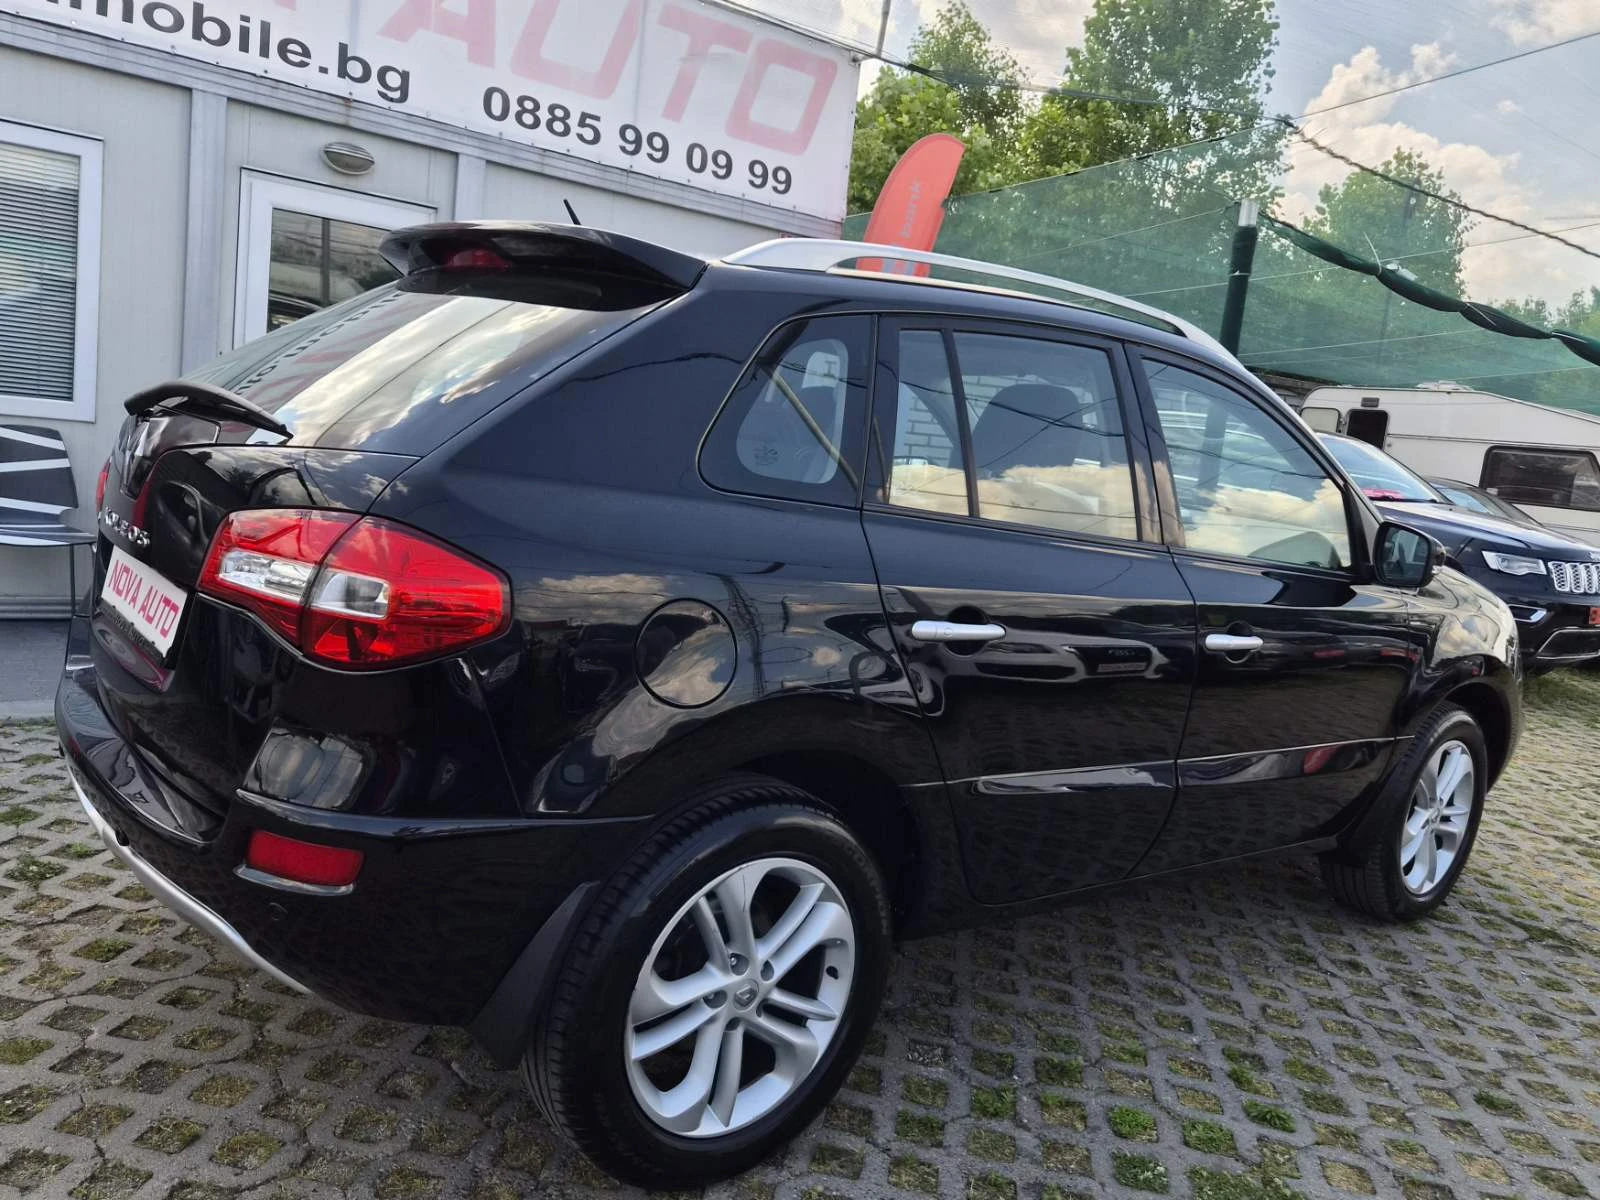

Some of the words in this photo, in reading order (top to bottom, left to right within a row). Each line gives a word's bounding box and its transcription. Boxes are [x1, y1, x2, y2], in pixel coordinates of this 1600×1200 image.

[482, 86, 601, 146] 0885
[618, 123, 670, 164] 99
[686, 142, 733, 180] 09
[748, 159, 792, 195] 99
[107, 559, 142, 609] NOVA
[139, 586, 180, 639] AUTO
